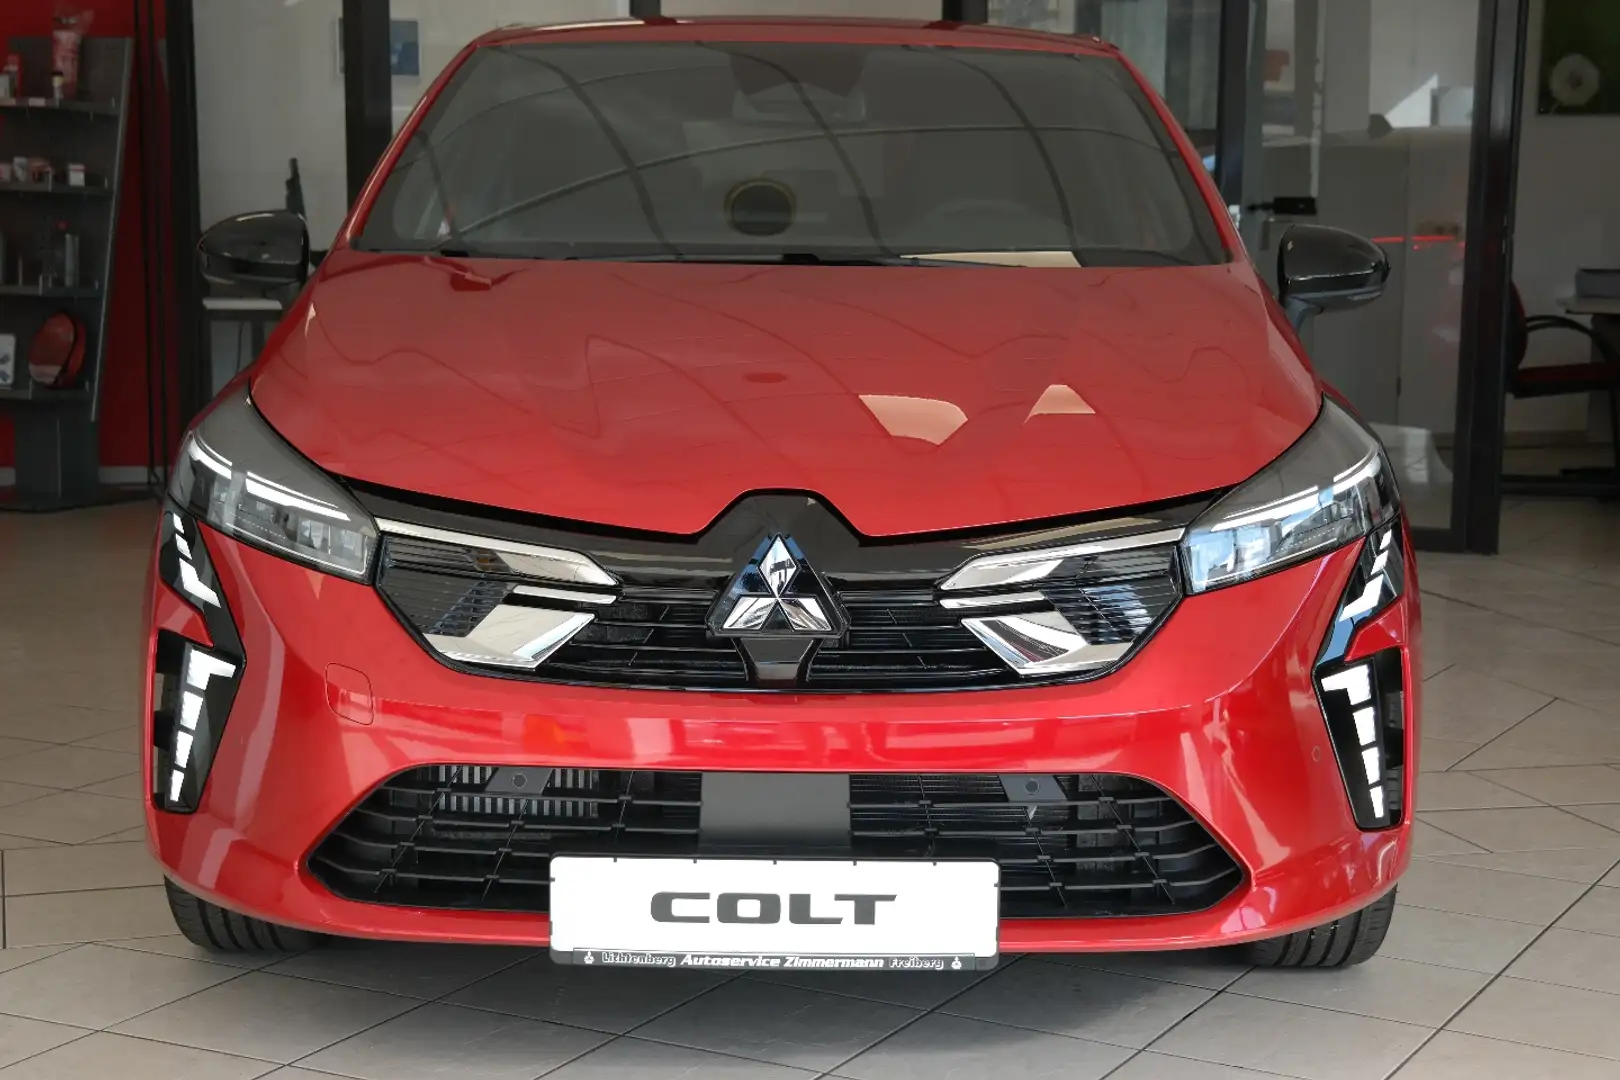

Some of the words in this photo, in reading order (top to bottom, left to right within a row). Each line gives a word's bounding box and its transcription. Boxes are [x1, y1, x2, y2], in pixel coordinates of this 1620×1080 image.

[651, 892, 897, 925] COLT
[602, 952, 676, 967] Lichtenberg
[681, 954, 780, 967] Autoservice
[784, 956, 884, 968] Zimmermann
[890, 957, 944, 970] Freiberg
